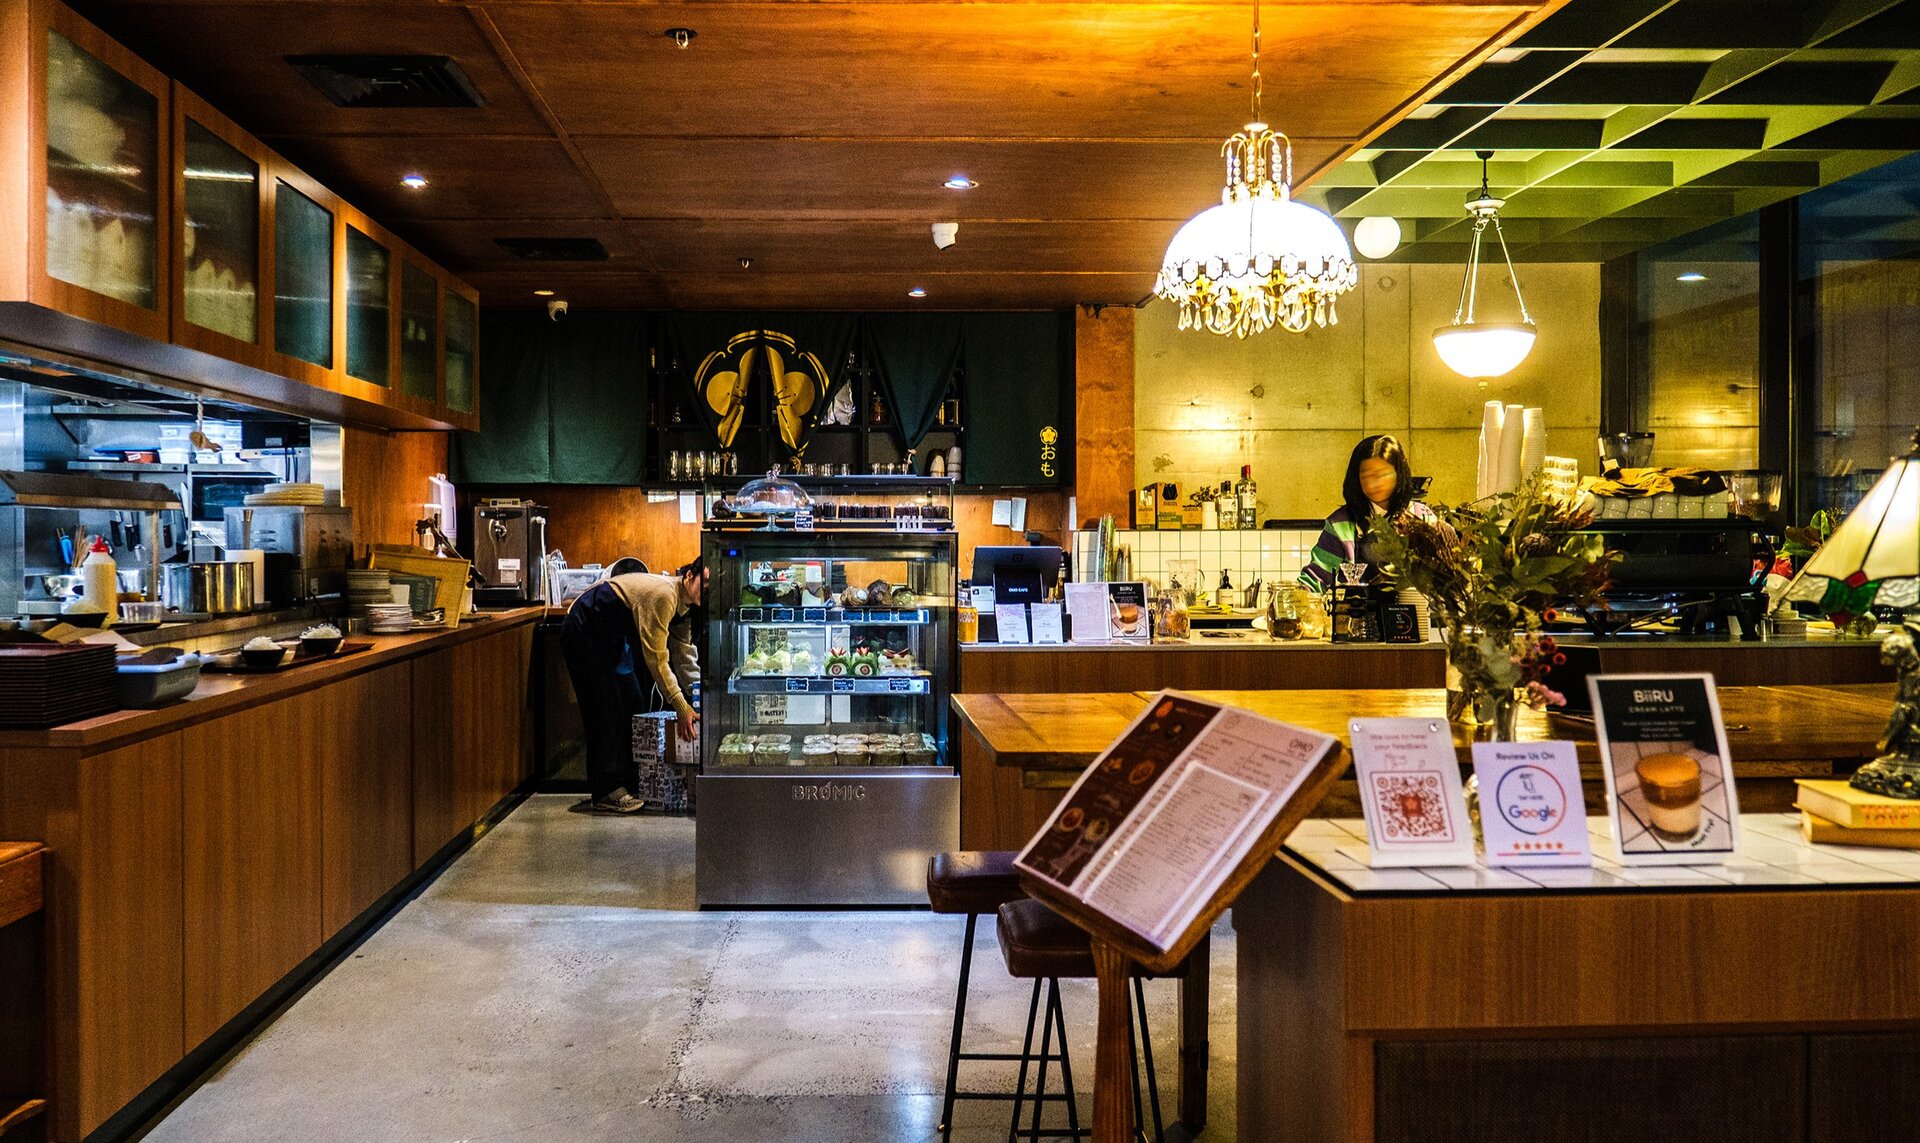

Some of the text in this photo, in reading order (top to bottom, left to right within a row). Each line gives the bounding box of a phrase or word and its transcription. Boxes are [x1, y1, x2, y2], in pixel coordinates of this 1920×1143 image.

[1632, 689, 1674, 703] BiiRU
[1541, 752, 1555, 760] On
[1509, 804, 1557, 822] Google
